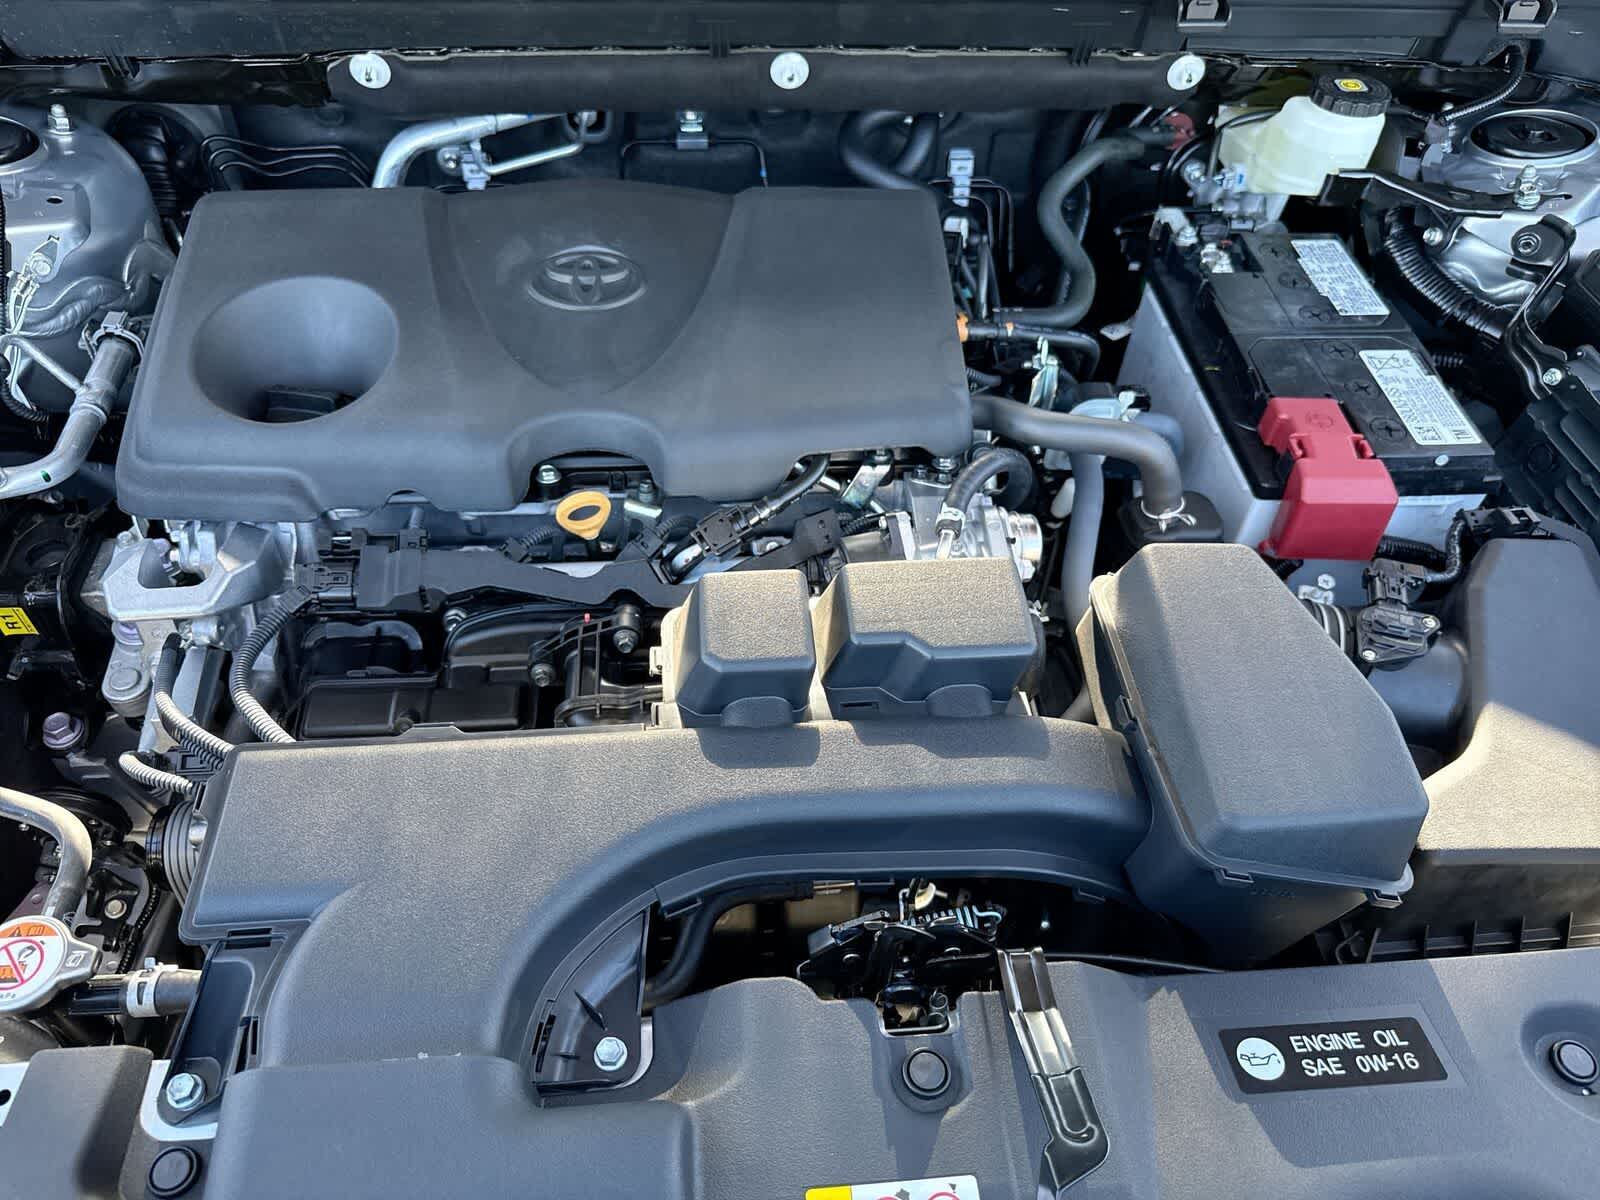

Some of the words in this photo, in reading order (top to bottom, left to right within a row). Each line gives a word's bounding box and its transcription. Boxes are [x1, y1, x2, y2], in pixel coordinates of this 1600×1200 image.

[1289, 1031, 1364, 1053] ENGINE
[1373, 1029, 1408, 1048] OIL
[1301, 1057, 1346, 1077] SAE
[1355, 1052, 1420, 1073] 0W-16
